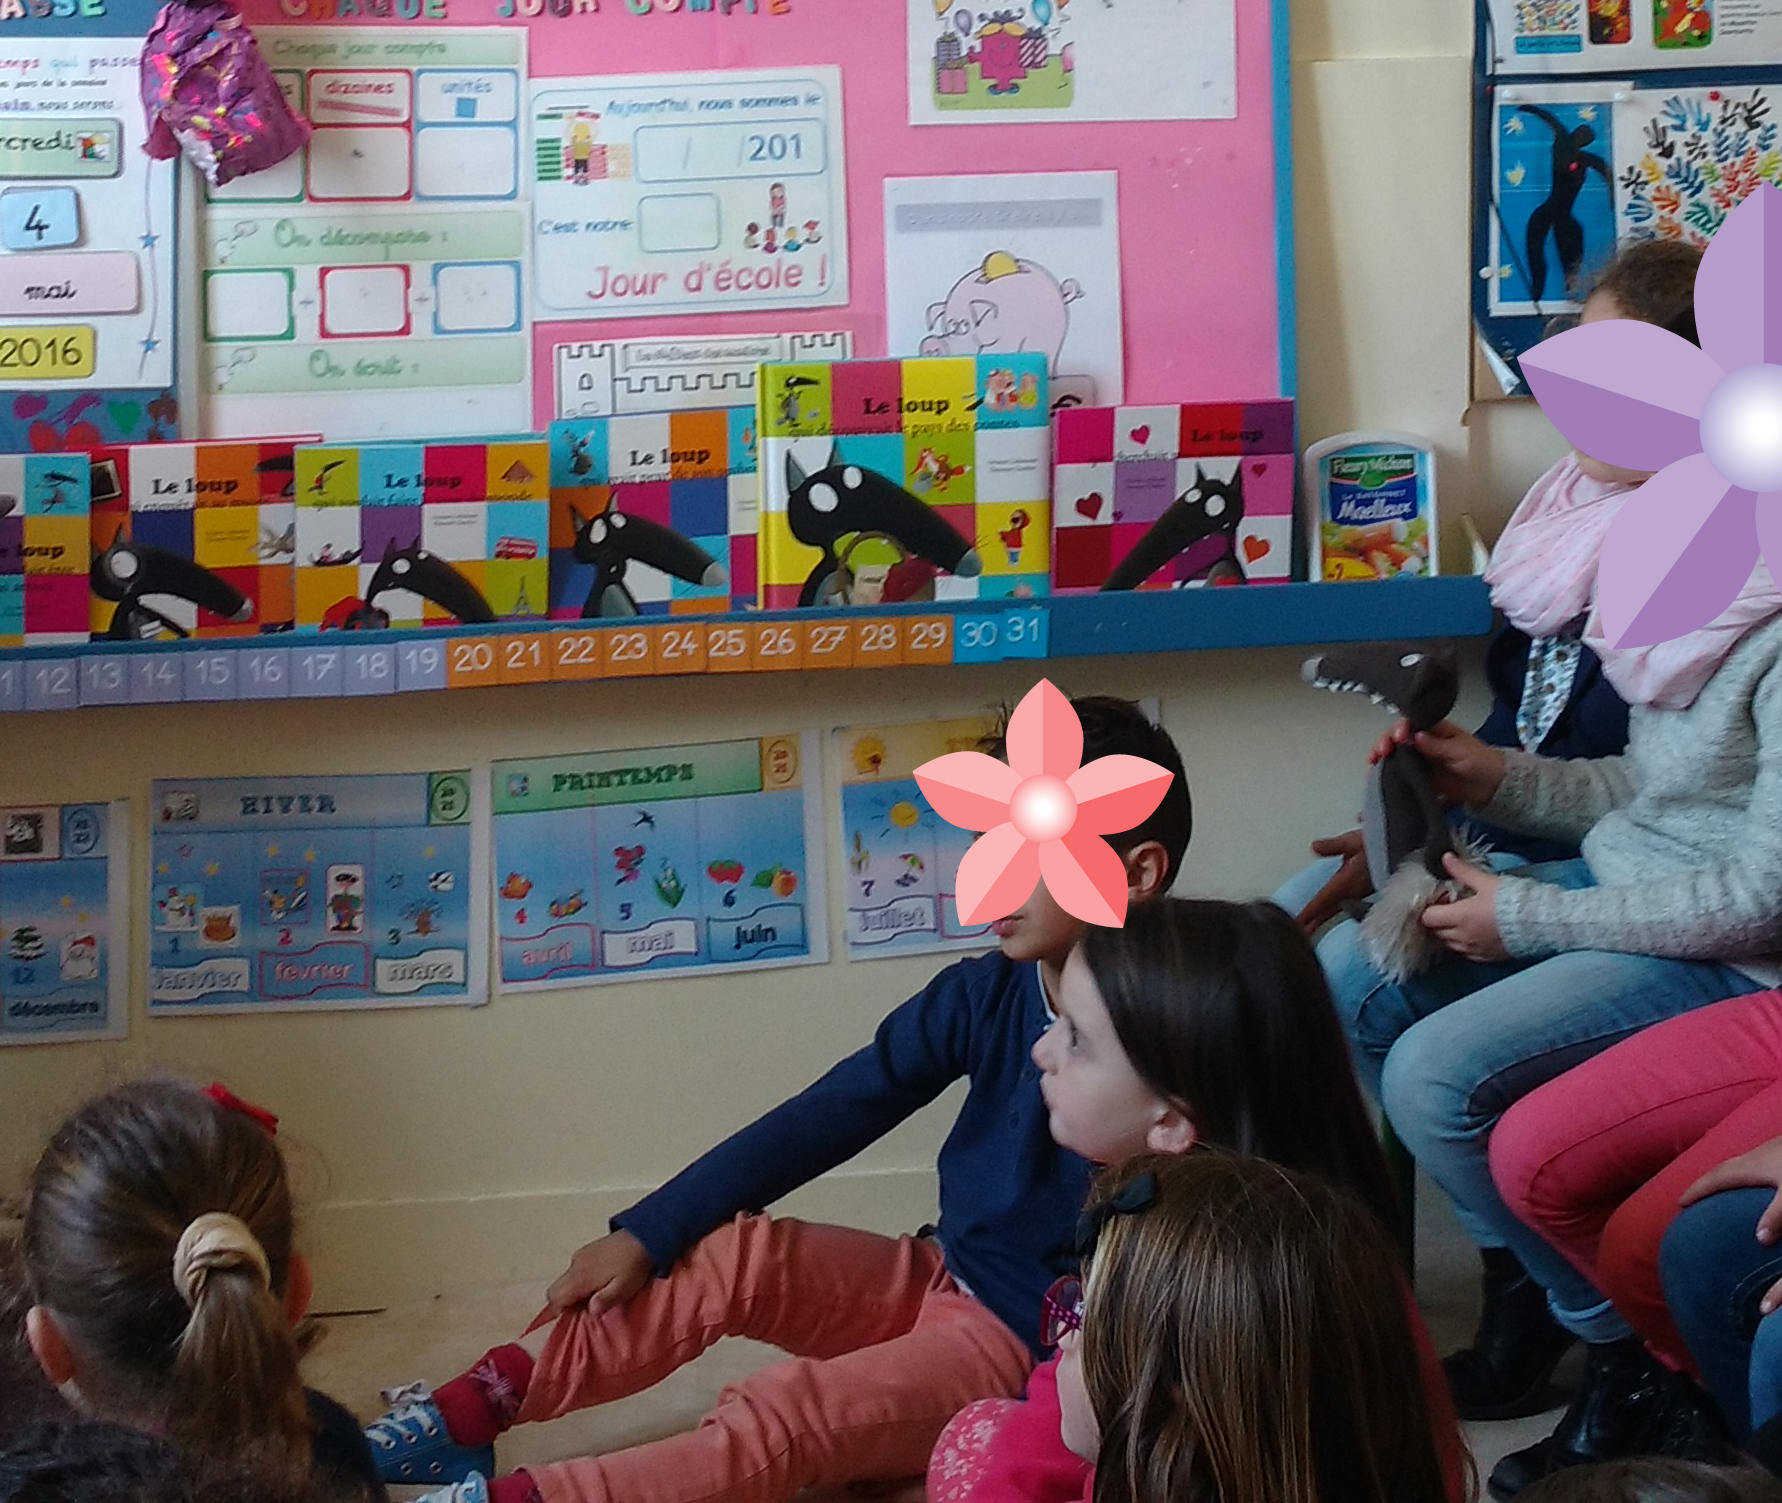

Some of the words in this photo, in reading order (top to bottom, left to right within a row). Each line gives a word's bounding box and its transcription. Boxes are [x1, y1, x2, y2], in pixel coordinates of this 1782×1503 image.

[325, 78, 395, 96] dizaines
[747, 132, 804, 164] 201
[24, 204, 51, 240] 4
[586, 264, 667, 301] Jour
[683, 258, 804, 295] d'école
[23, 280, 77, 301] mai
[863, 397, 889, 415] Le
[898, 397, 949, 415] loup
[630, 450, 655, 466] Le
[660, 448, 711, 464] loup
[152, 478, 178, 495] Le
[185, 477, 238, 494] loup
[35, 666, 72, 695] 12
[87, 662, 120, 689] 13
[142, 660, 178, 688] 14
[196, 657, 231, 684] 15
[248, 653, 283, 683] 16
[301, 653, 336, 681] 17
[355, 651, 388, 678] 18
[405, 647, 440, 674] 19
[454, 643, 492, 671] 20
[506, 640, 541, 668] 21
[558, 638, 595, 663] 22
[610, 633, 648, 660] 23
[661, 630, 697, 657] 24
[708, 629, 747, 658] 25
[759, 627, 797, 656] 26
[810, 624, 848, 654] 27
[861, 623, 898, 652] 28
[911, 621, 949, 650] 29
[960, 619, 999, 648] 30
[1007, 614, 1041, 644] 31
[551, 762, 695, 792] PRINTEMPS
[733, 924, 777, 950] juin
[522, 942, 572, 965] avril
[274, 960, 355, 981] février
[388, 963, 453, 981] mars
[9, 1000, 100, 1019] décembre
